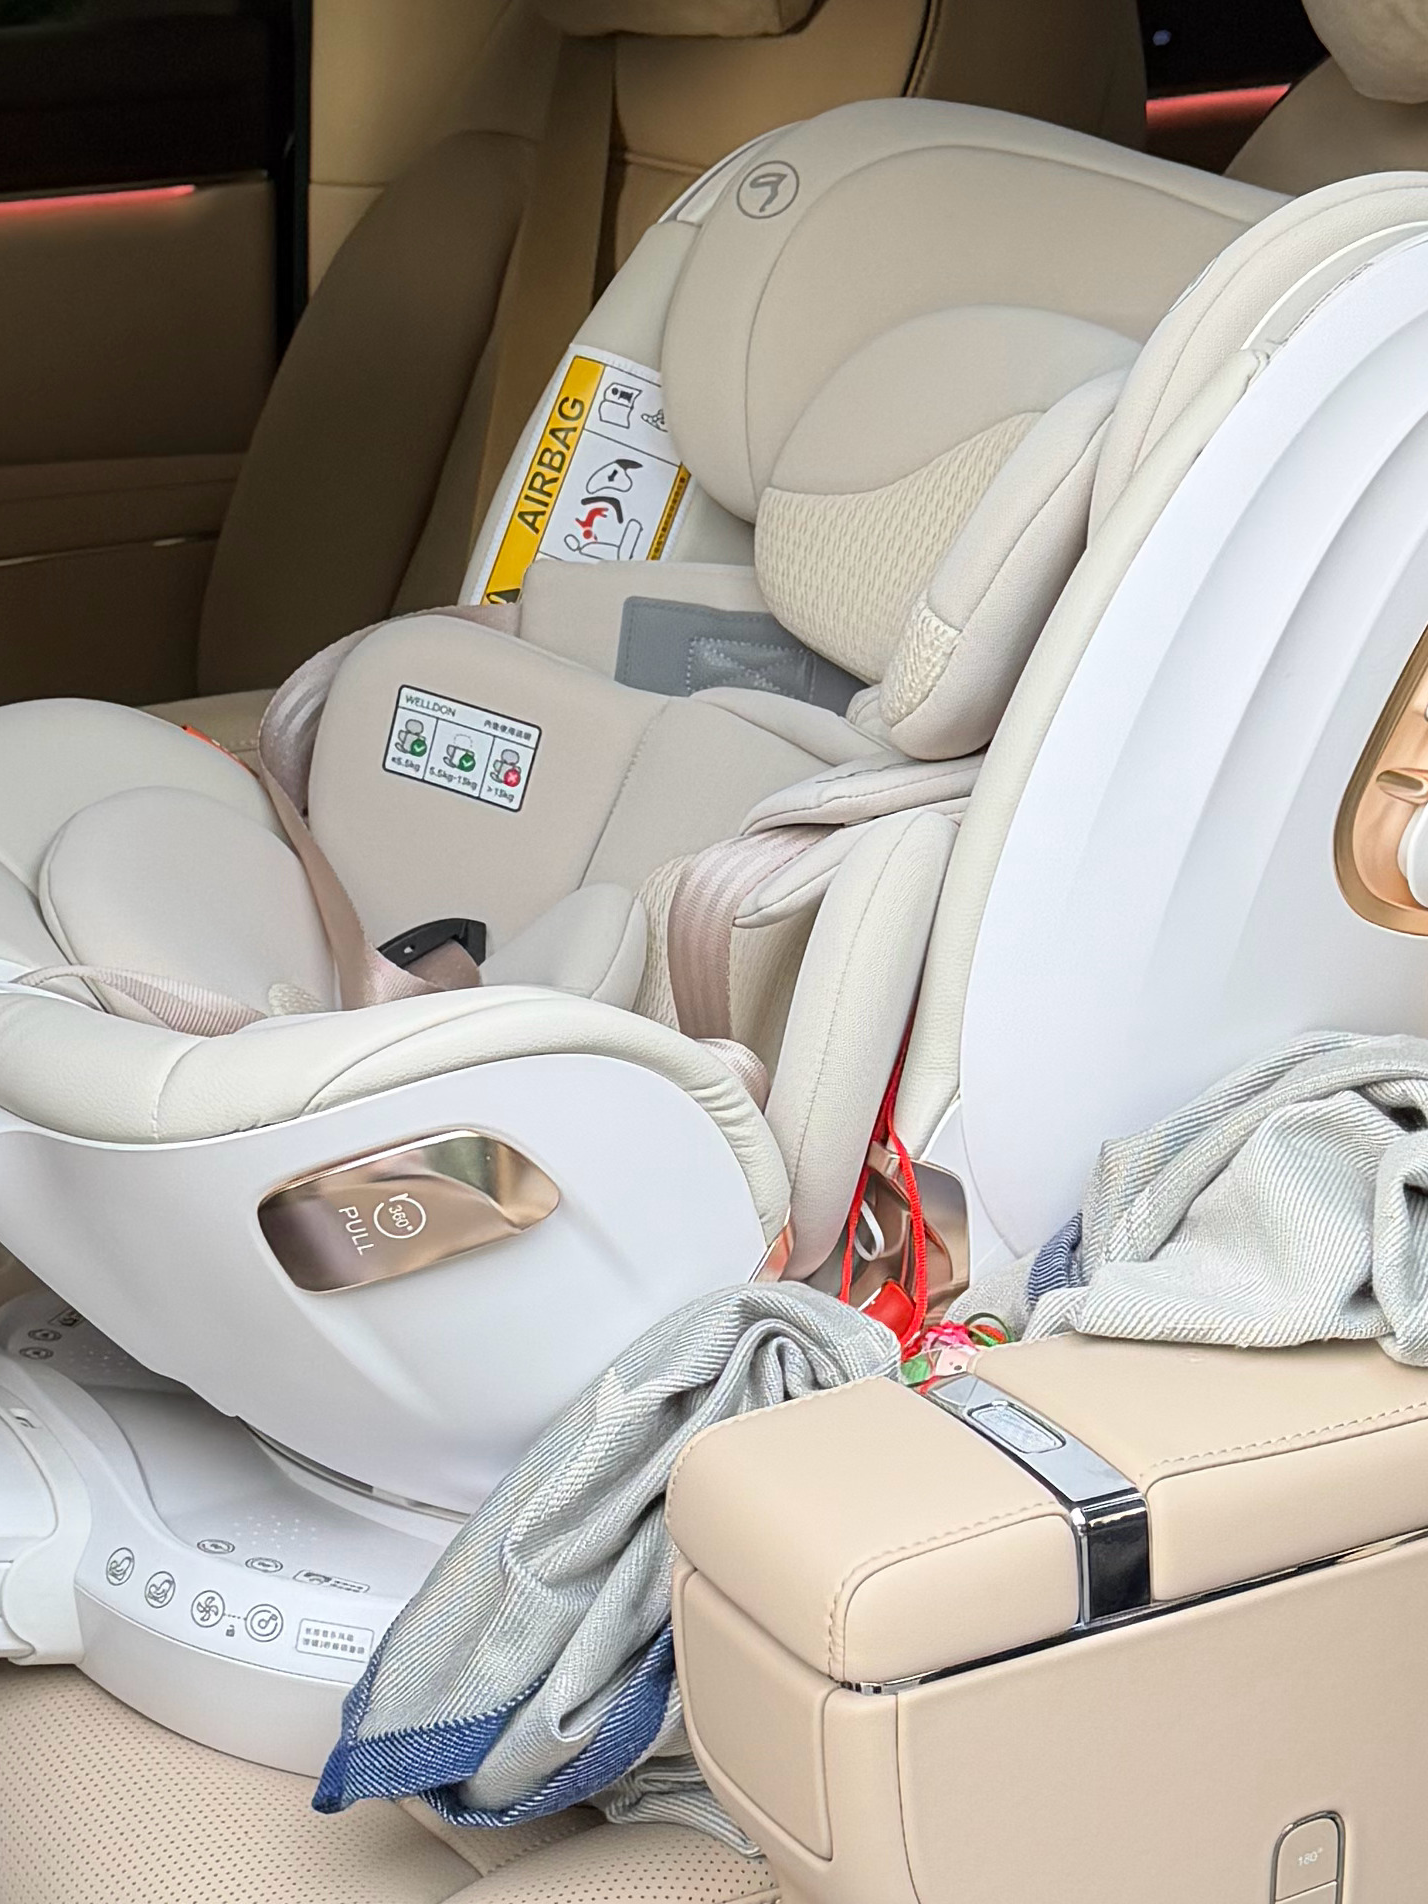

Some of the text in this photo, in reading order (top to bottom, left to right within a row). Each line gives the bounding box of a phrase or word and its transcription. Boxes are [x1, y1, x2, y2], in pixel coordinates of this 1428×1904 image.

[517, 397, 585, 535] AIRBAG
[405, 695, 457, 717] WELLDON
[338, 1206, 375, 1256] PULL
[388, 1204, 414, 1231] 360°
[1298, 1847, 1323, 1866] 180°
